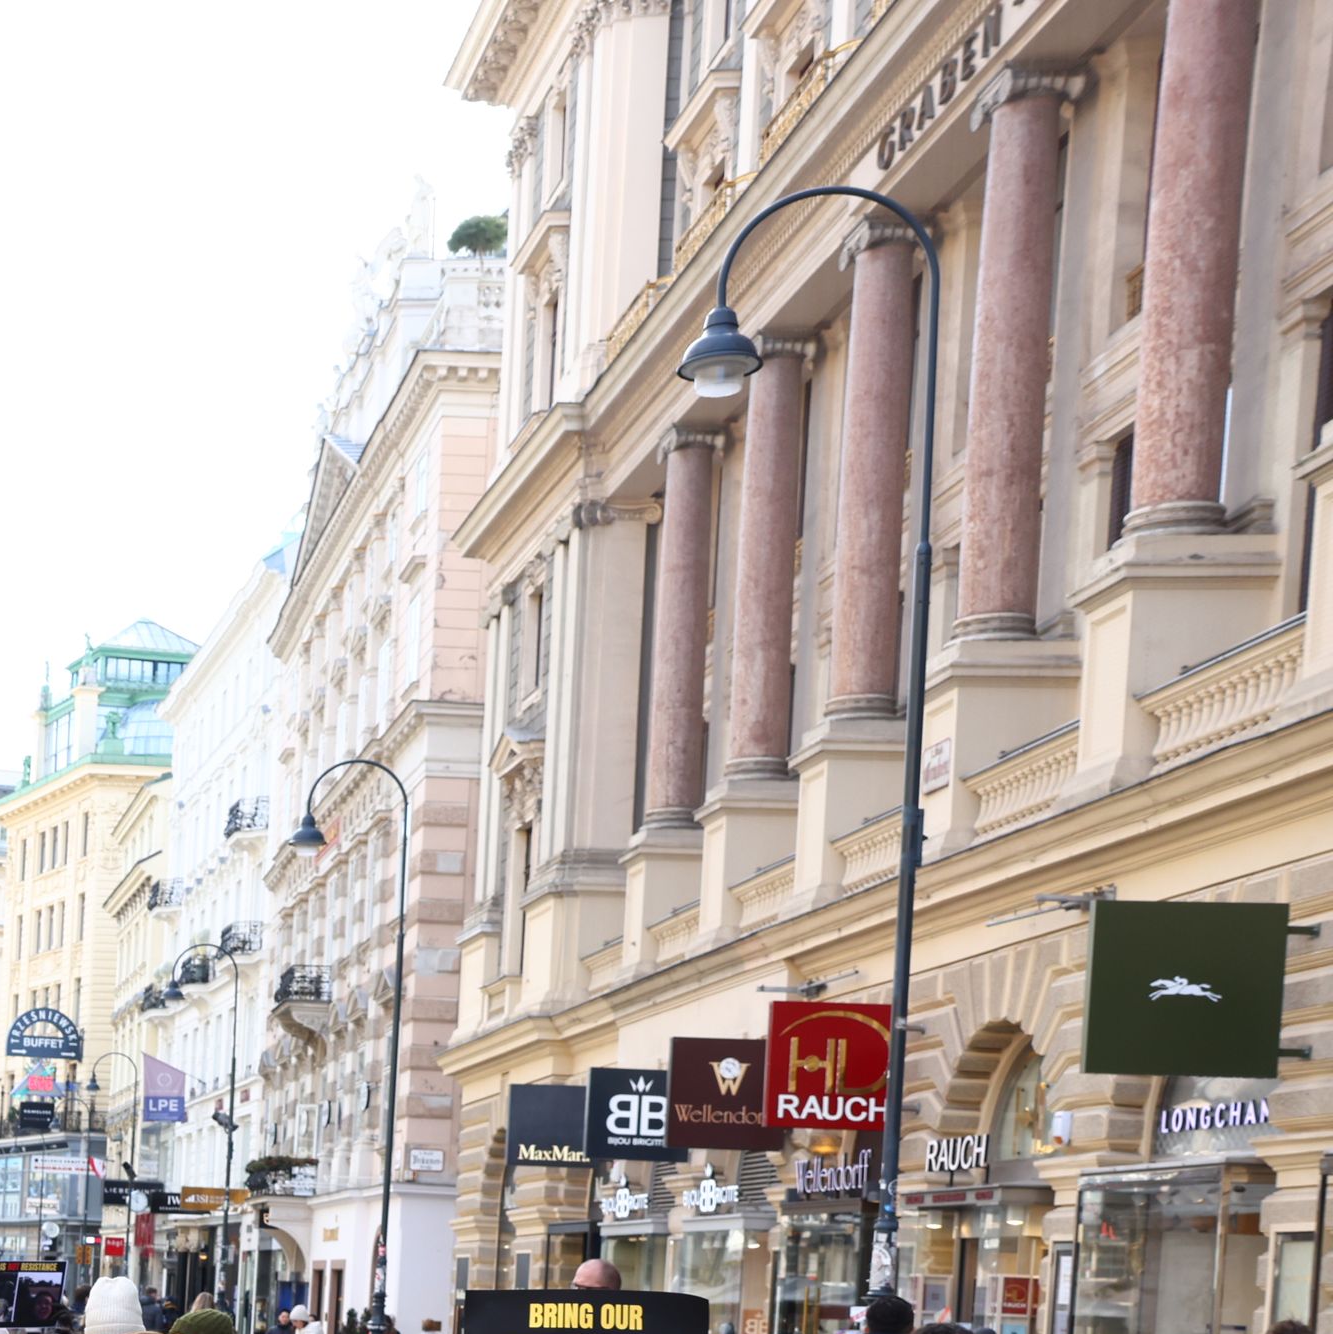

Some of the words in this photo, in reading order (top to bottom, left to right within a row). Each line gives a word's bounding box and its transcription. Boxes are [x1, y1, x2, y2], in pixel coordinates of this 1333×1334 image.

[877, 3, 1003, 170] GRABEN
[23, 1037, 65, 1049] BUFFET
[148, 1098, 179, 1112] LPE
[675, 1103, 764, 1126] Wellendor
[776, 1093, 887, 1122] RAUCH
[1160, 1097, 1270, 1134] LONGCHAM
[632, 1137, 666, 1146] BRIGITT
[925, 1134, 989, 1172] RAUCH
[794, 1149, 872, 1194] Wellendorff
[167, 1196, 181, 1205] IW
[528, 1303, 594, 1330] BRING
[600, 1304, 643, 1331] OUR
